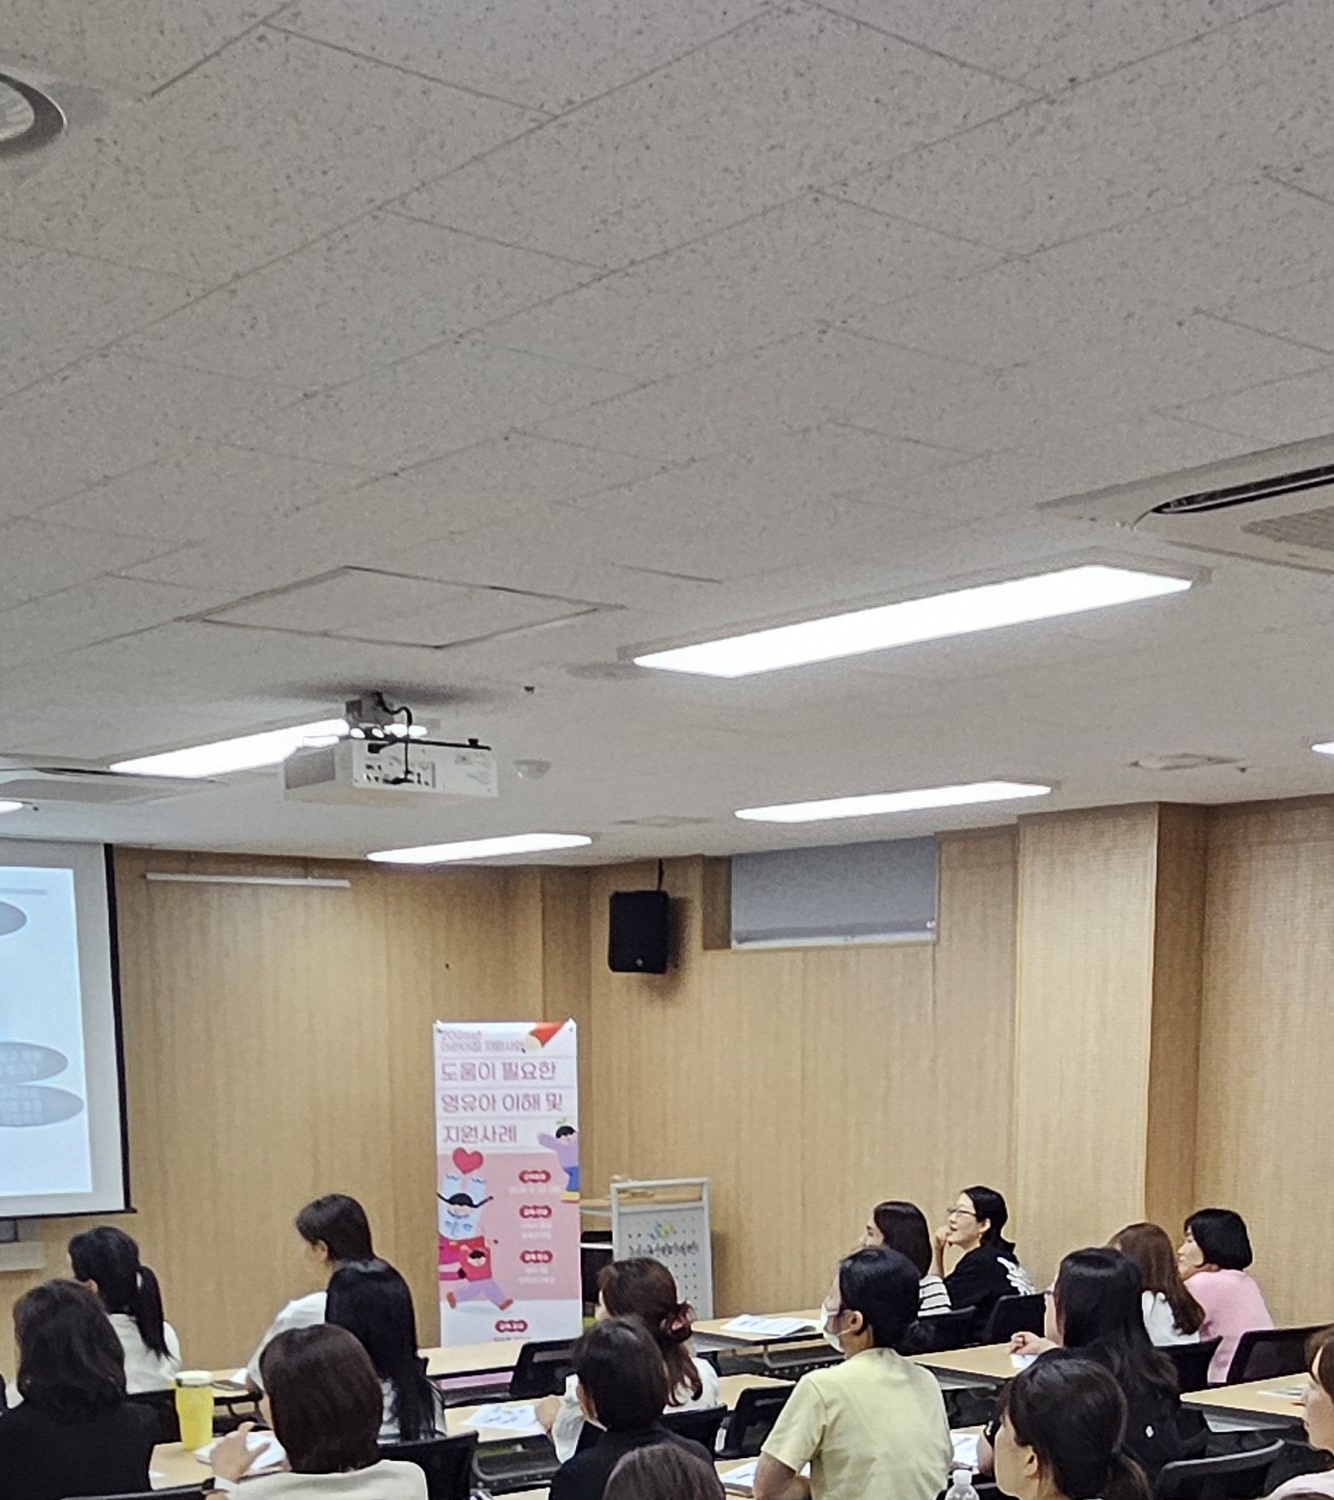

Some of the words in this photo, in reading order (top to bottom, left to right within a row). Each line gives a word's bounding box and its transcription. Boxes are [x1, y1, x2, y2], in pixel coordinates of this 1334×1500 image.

[441, 1061, 496, 1081] 도움이
[502, 1061, 556, 1081] 필요한
[441, 1093, 496, 1113] 영유아
[502, 1093, 541, 1113] 이해
[545, 1092, 563, 1112] 및
